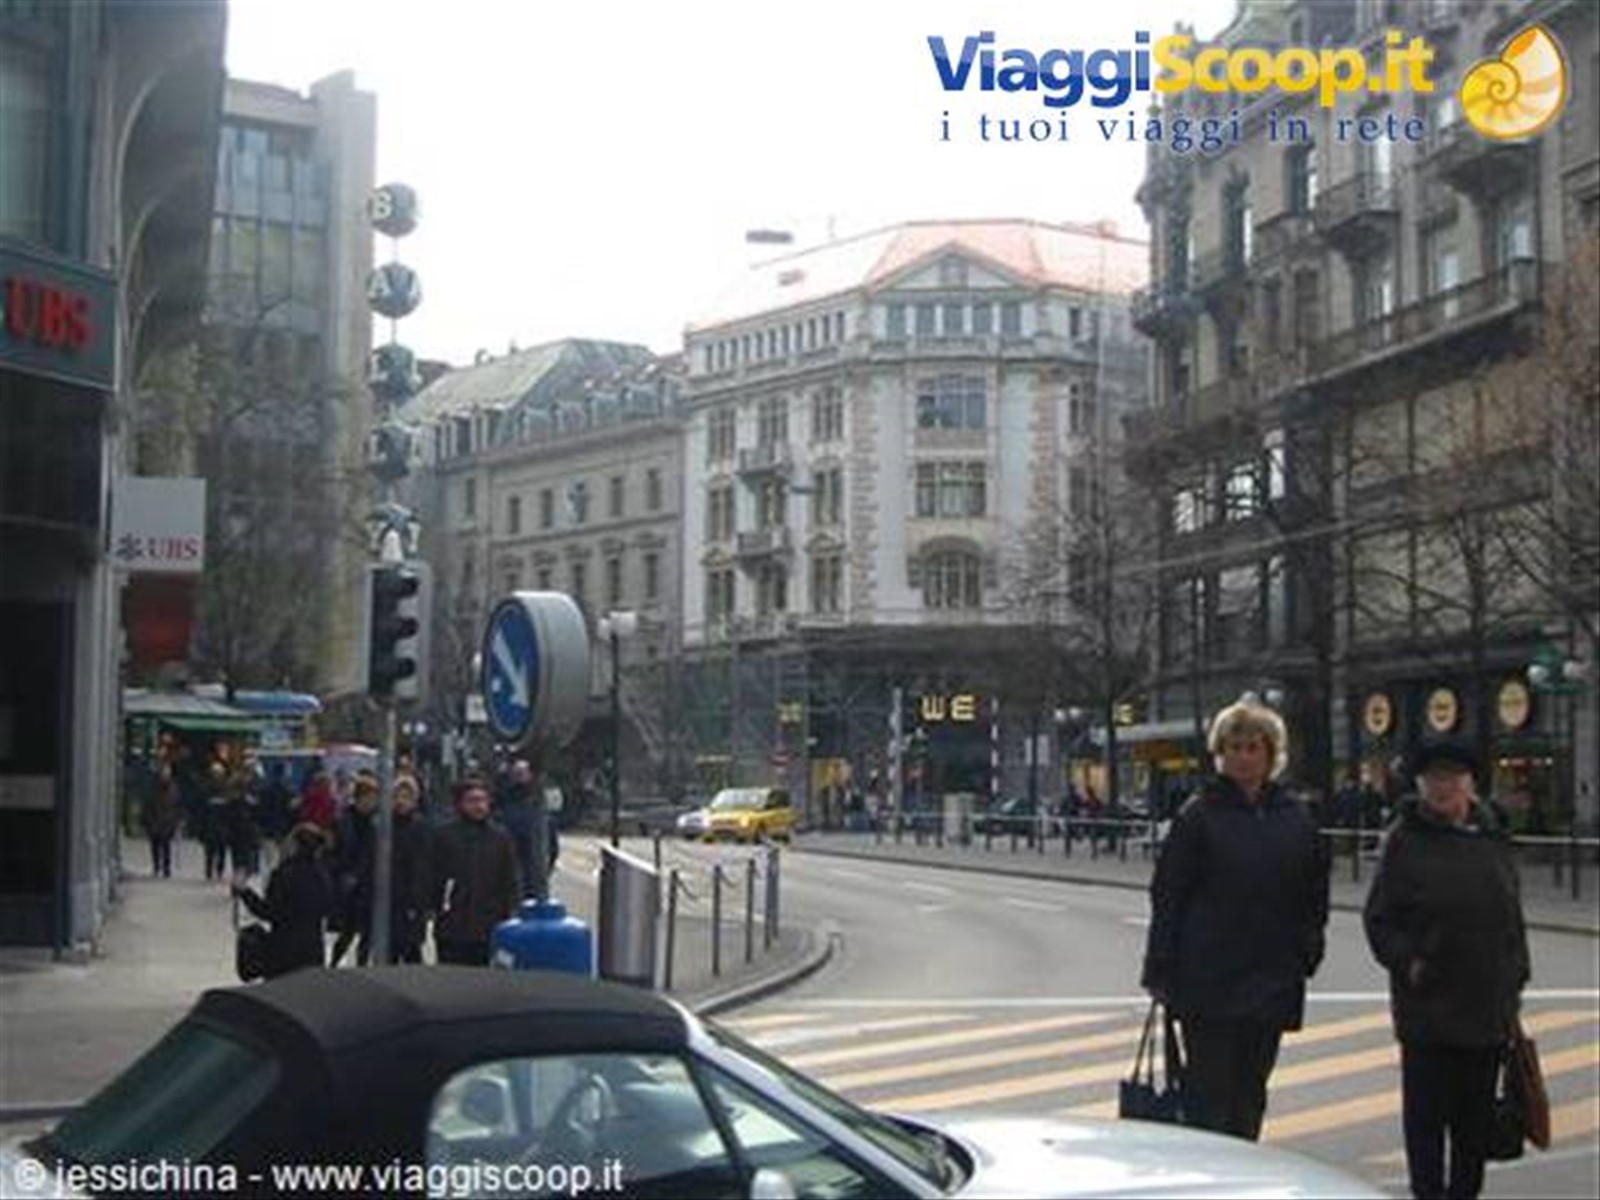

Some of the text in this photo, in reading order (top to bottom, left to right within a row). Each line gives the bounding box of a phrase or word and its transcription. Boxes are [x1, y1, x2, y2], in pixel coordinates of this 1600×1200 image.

[7, 275, 95, 348] UBS
[148, 536, 199, 560] UBS
[921, 695, 976, 720] WE
